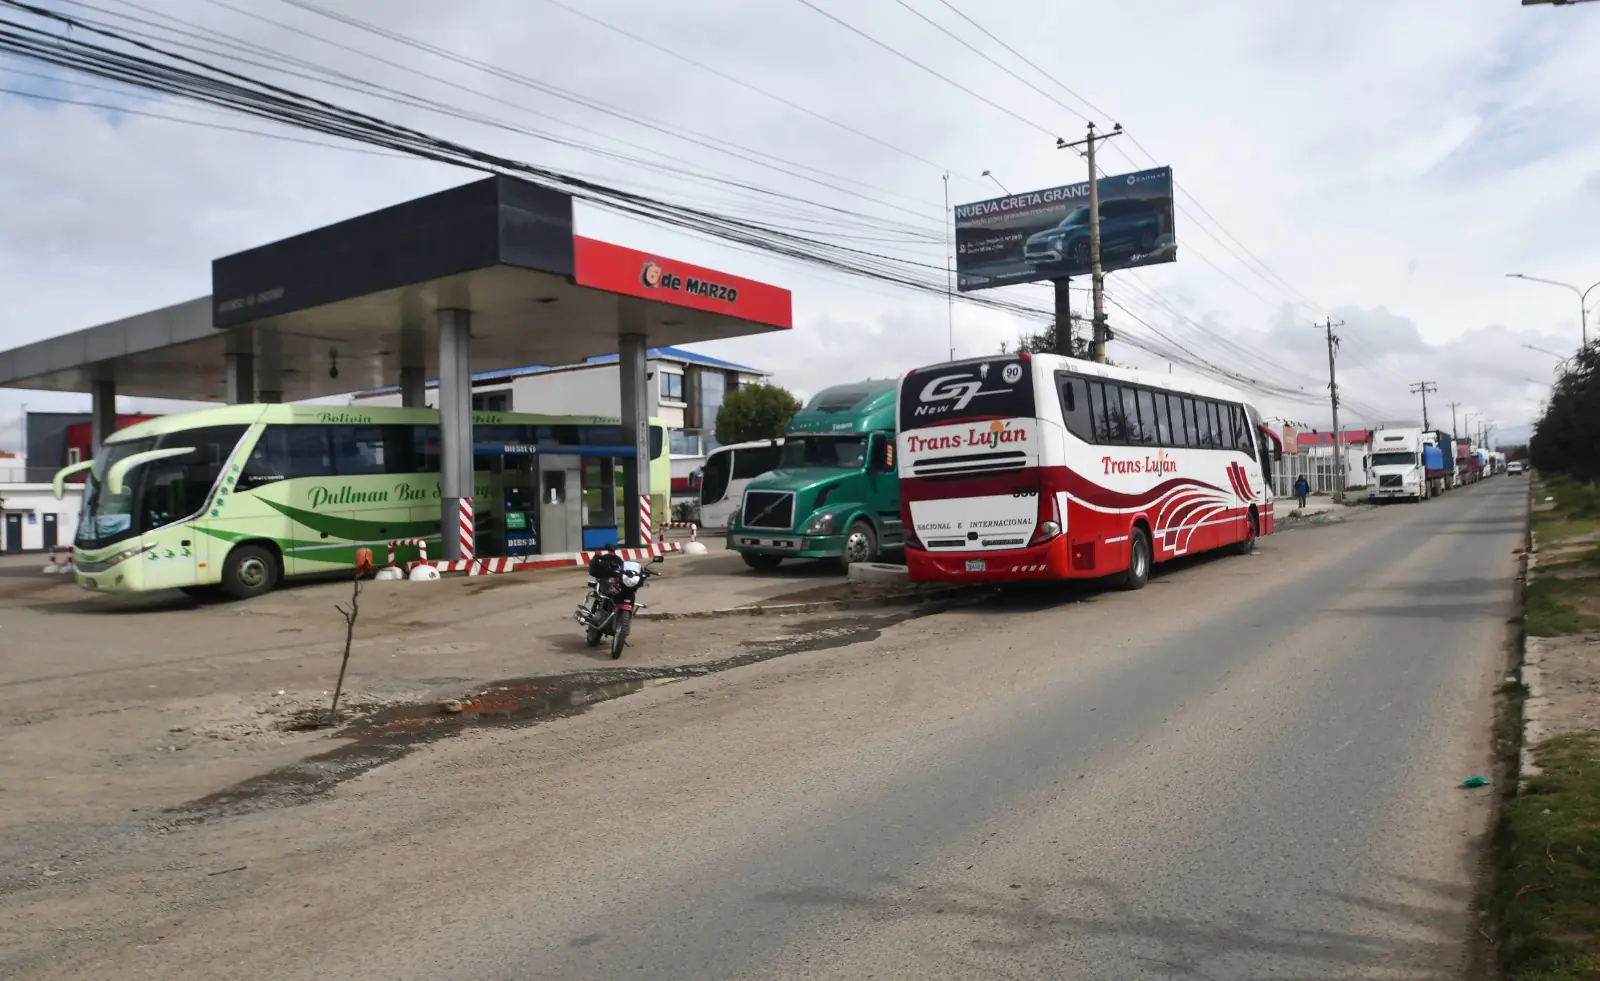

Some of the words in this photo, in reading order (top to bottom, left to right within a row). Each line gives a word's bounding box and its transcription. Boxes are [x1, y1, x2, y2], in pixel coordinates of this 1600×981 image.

[957, 201, 999, 218] NUEVA
[1000, 193, 1042, 211] CRETA
[661, 274, 680, 290] de
[686, 279, 737, 303] MARZO
[1006, 367, 1019, 378] 90
[914, 405, 949, 416] New
[308, 486, 388, 508] Pullman
[394, 483, 426, 500] Bus
[917, 522, 951, 531] NACIONAL
[969, 518, 1033, 529] INTERNACIONAL
